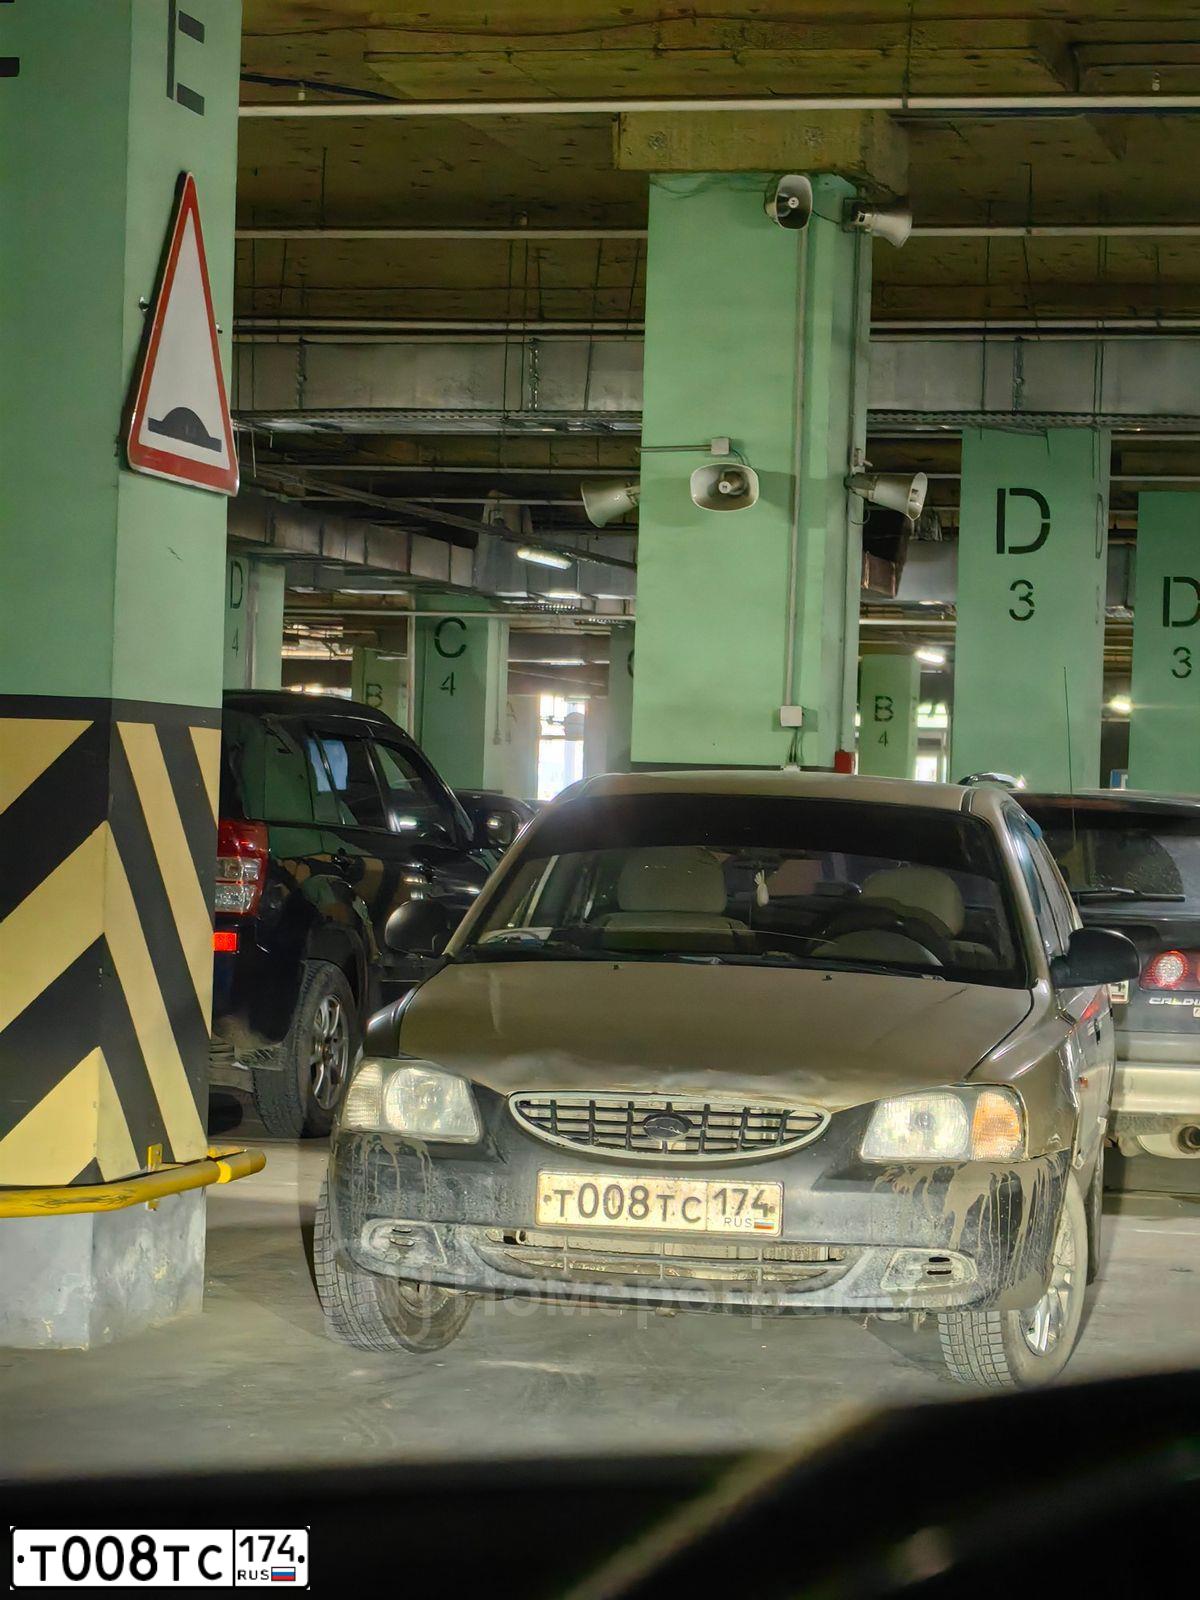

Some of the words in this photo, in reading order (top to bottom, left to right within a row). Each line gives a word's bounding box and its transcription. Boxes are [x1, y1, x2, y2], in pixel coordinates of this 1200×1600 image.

[997, 487, 1050, 554] D
[230, 560, 243, 609] D
[1009, 579, 1035, 622] 3
[1162, 576, 1200, 628] D
[231, 626, 239, 657] 4
[434, 616, 467, 658] C
[1172, 646, 1193, 679] 3
[366, 683, 383, 708] B
[440, 671, 456, 697] 4
[874, 695, 894, 722] B
[878, 730, 889, 748] 4
[713, 1187, 770, 1218] 174
[724, 1217, 753, 1229] RUS
